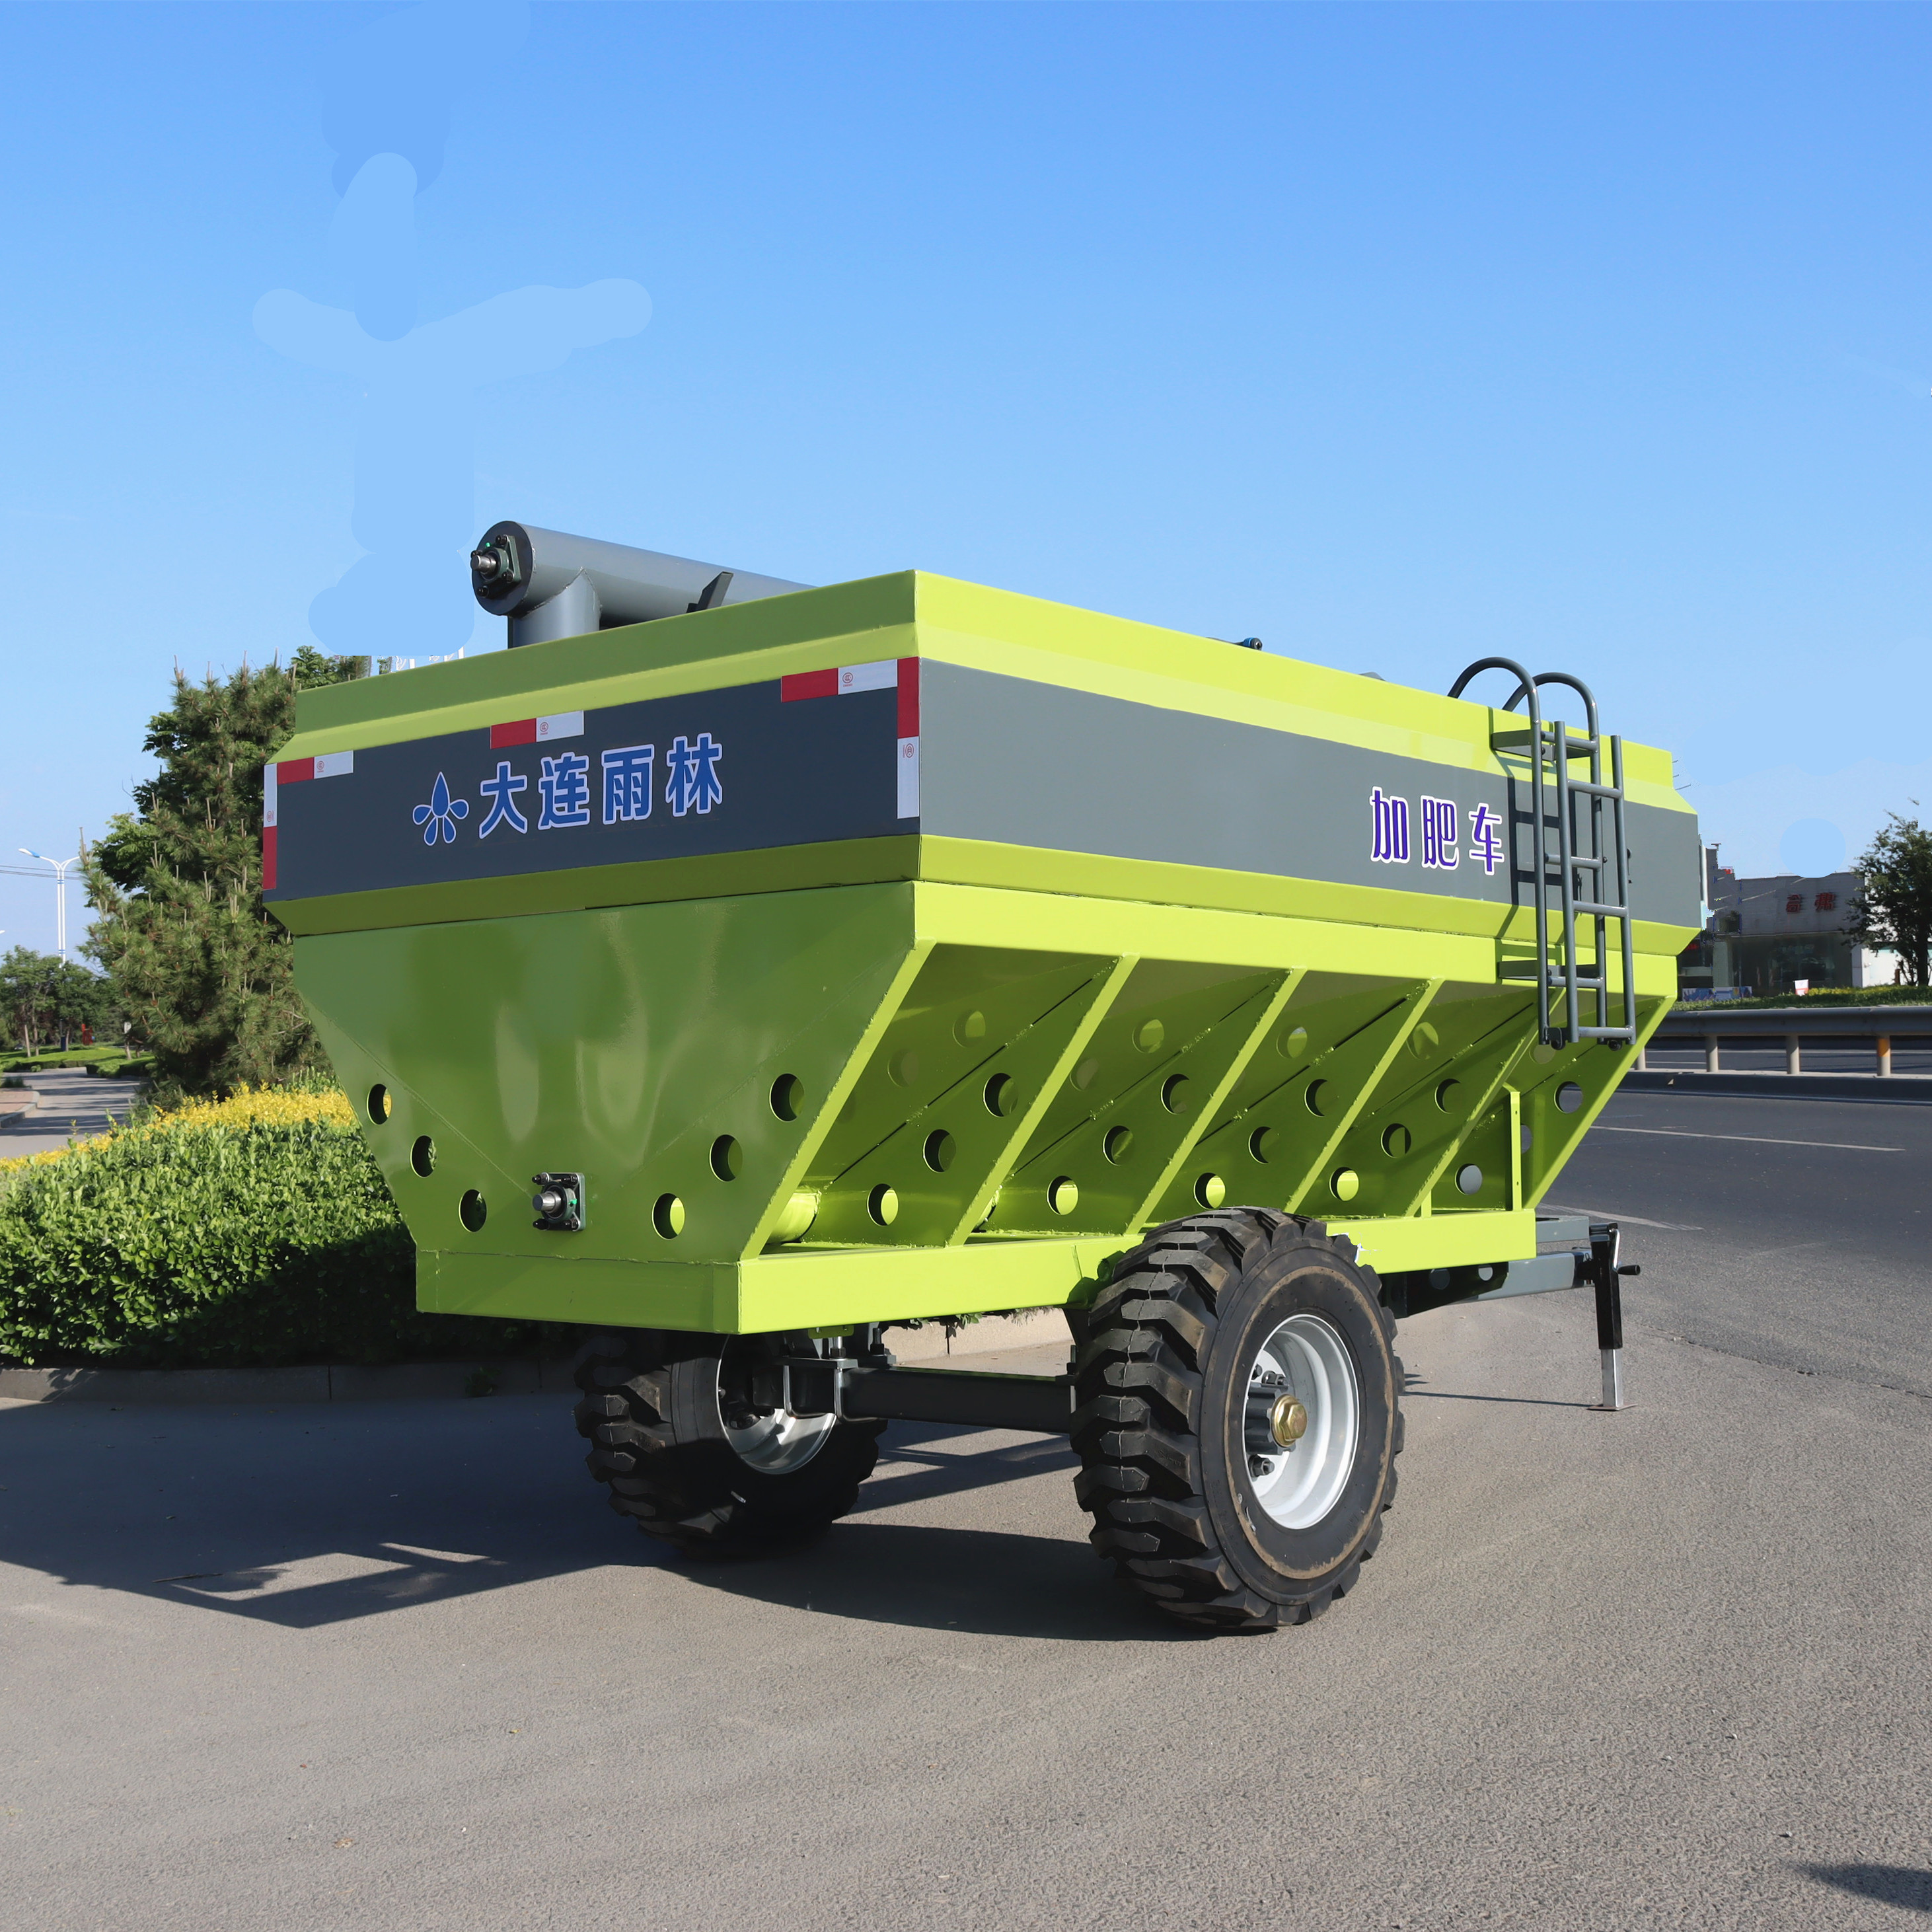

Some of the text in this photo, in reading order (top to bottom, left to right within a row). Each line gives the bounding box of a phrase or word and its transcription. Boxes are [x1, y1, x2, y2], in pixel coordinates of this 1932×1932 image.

[478, 732, 723, 839] 大连雨林
[1370, 786, 1505, 875] 加肥车
